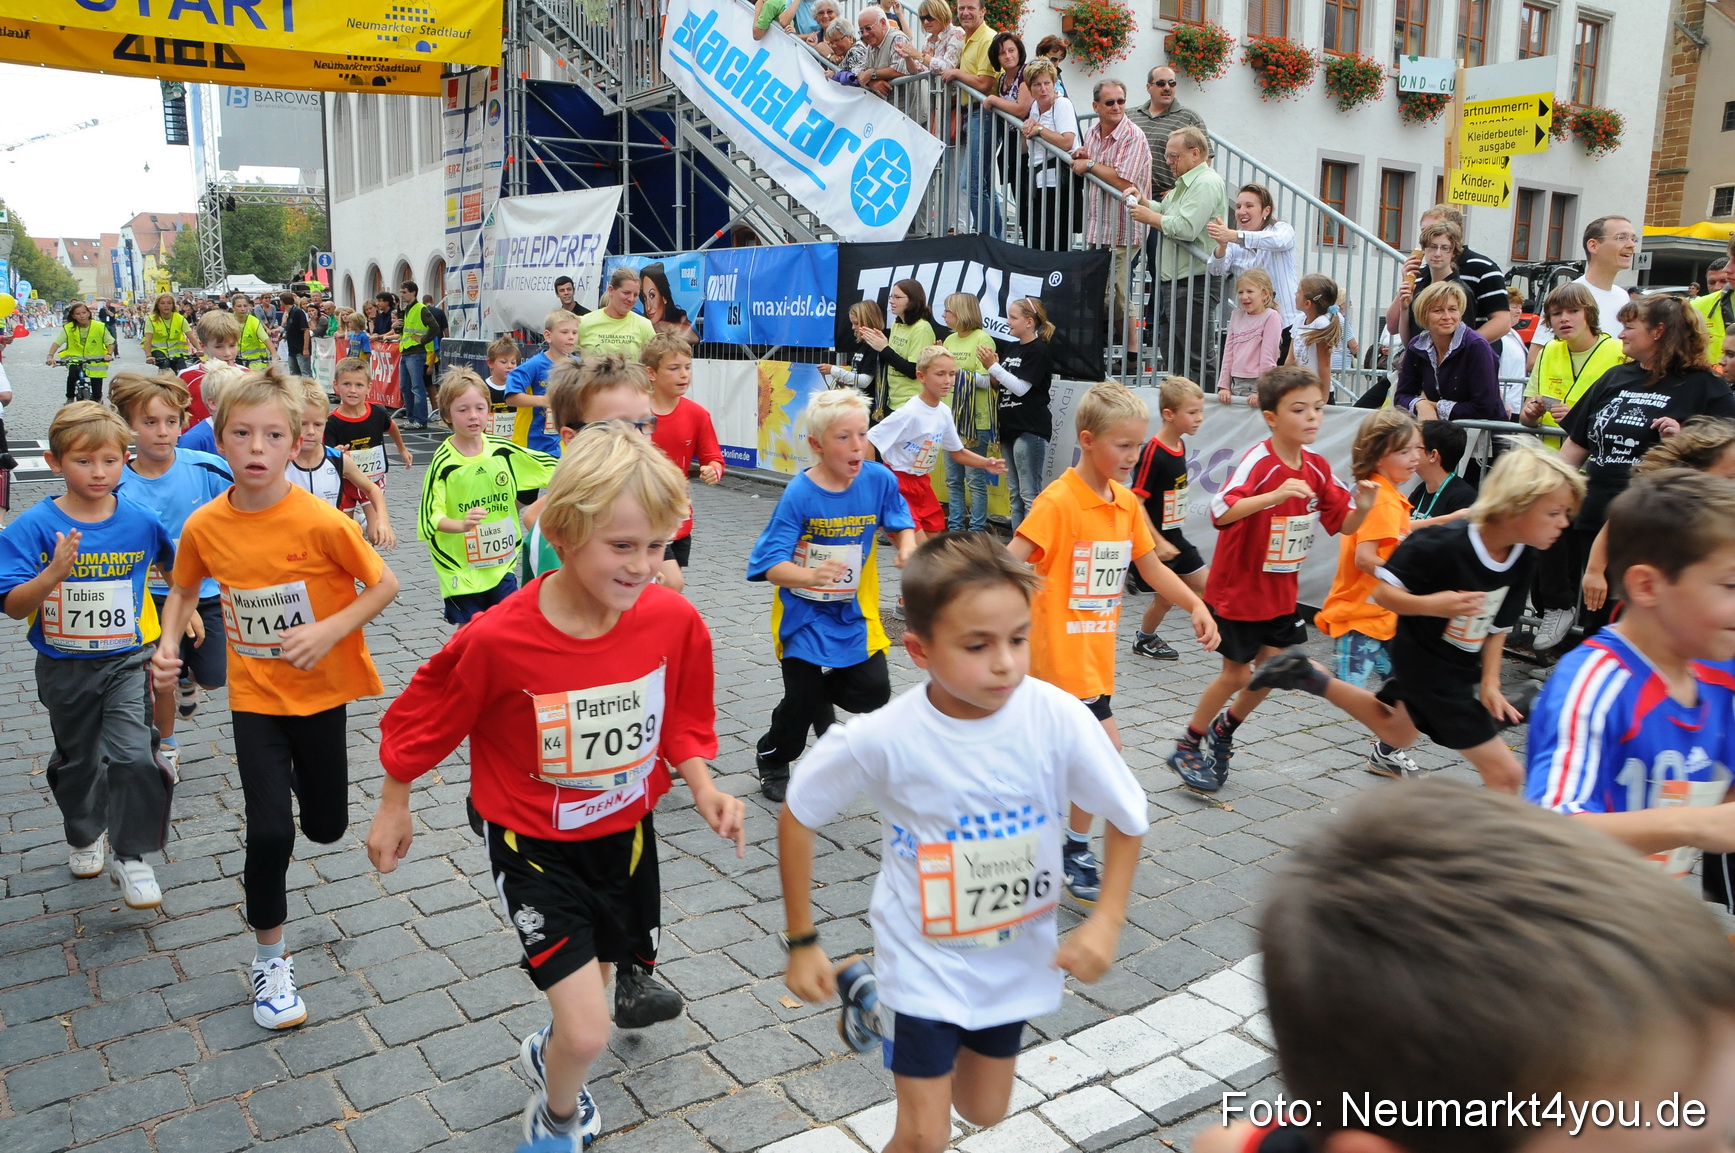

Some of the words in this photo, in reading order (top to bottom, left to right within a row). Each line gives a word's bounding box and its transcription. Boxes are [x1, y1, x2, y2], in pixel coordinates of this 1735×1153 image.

[346, 17, 417, 34] Neumarkter
[419, 23, 472, 40] Stadtlauf
[313, 59, 372, 72] Neumarkter
[375, 62, 422, 74] Stadtlauf
[1463, 101, 1534, 118] artnummern-
[1467, 126, 1529, 142] Kleiderbeutel-
[1478, 141, 1516, 154] ausgabe
[1461, 173, 1495, 188] Kinder-
[1452, 188, 1500, 207] betreuung
[508, 233, 602, 268] PFLEIDERER
[681, 266, 697, 278] maxi
[707, 268, 738, 302] maxi
[727, 302, 742, 326] dsl
[753, 294, 837, 318] maxi-dsl.de
[1619, 389, 1671, 402] Neumarkter
[1627, 398, 1668, 409] STADTLAUF
[1046, 387, 1073, 477] EDV-Systeme
[458, 492, 508, 513] SAMSUNG
[485, 503, 509, 514] obile
[809, 514, 877, 528] NEUMARKTER
[1288, 520, 1311, 533] Tobias
[480, 527, 501, 537] Lukas
[806, 526, 865, 537] STADTLAUF
[483, 534, 514, 554] 7050
[74, 550, 146, 566] UMARKTER
[1095, 546, 1119, 560] Lukas
[68, 564, 133, 577] ADTLAUF
[66, 588, 105, 602] Tobias
[233, 591, 301, 609] Maximilian
[45, 606, 56, 617] K4
[67, 608, 127, 629] 7198
[240, 611, 306, 635] 7144
[576, 690, 641, 720] Patrick
[544, 736, 562, 751] K4
[580, 714, 656, 760] 7039
[585, 790, 624, 817] DEHN
[964, 844, 1035, 881] Yannick
[965, 871, 1051, 917] 7296
